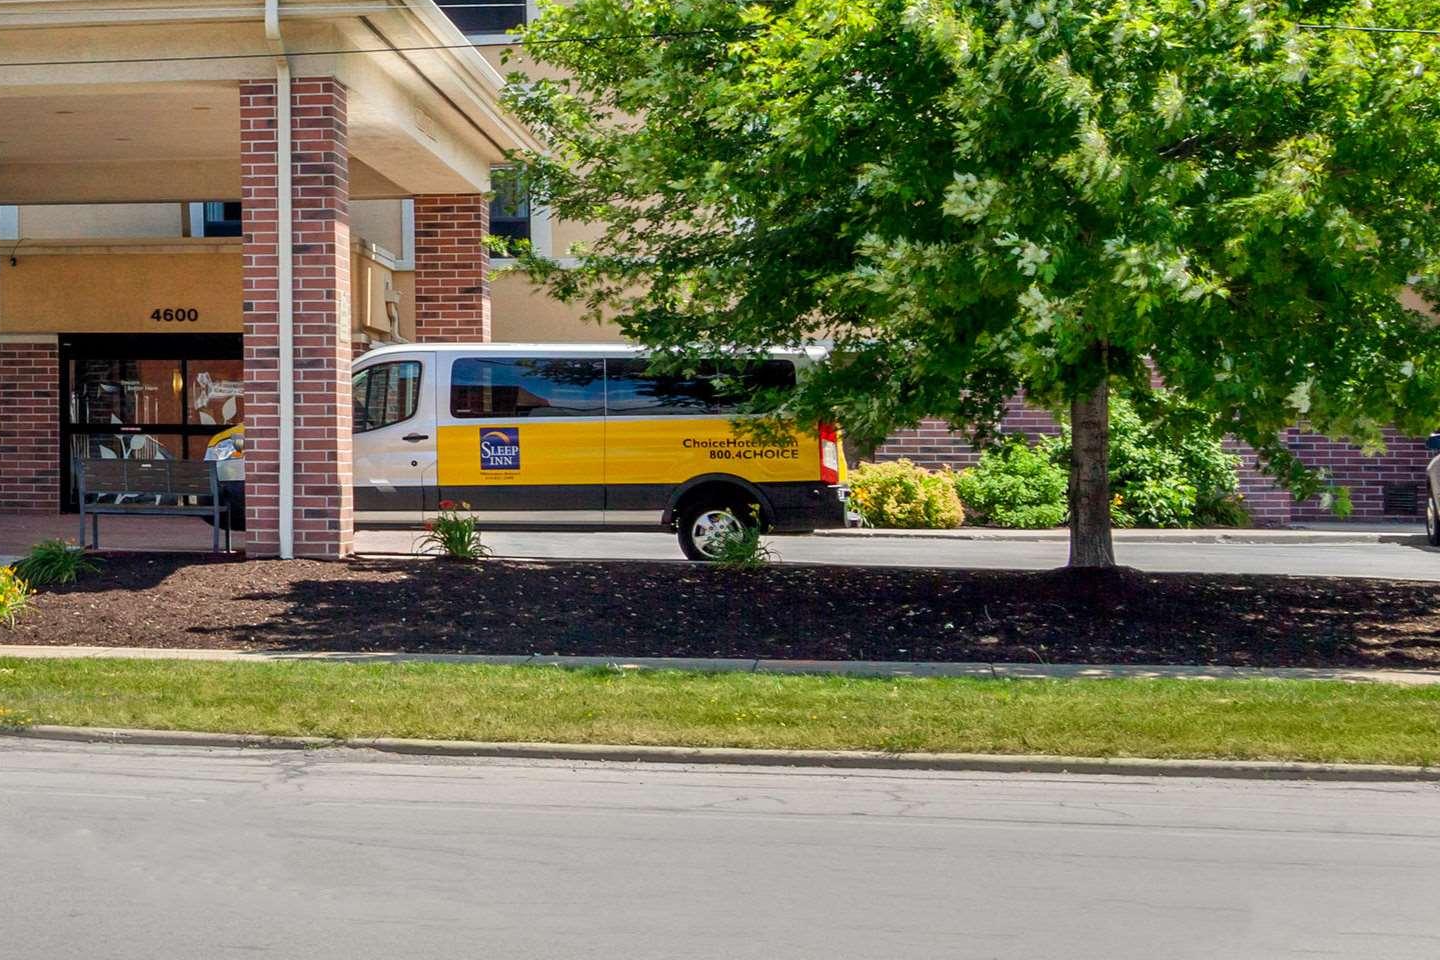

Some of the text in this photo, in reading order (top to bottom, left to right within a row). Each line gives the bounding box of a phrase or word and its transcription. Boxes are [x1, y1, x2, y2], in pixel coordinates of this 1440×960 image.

[151, 308, 198, 322] 4600
[481, 441, 519, 459] SLEEP
[709, 449, 799, 459] 800.4CHOICE
[490, 456, 513, 465] INN
